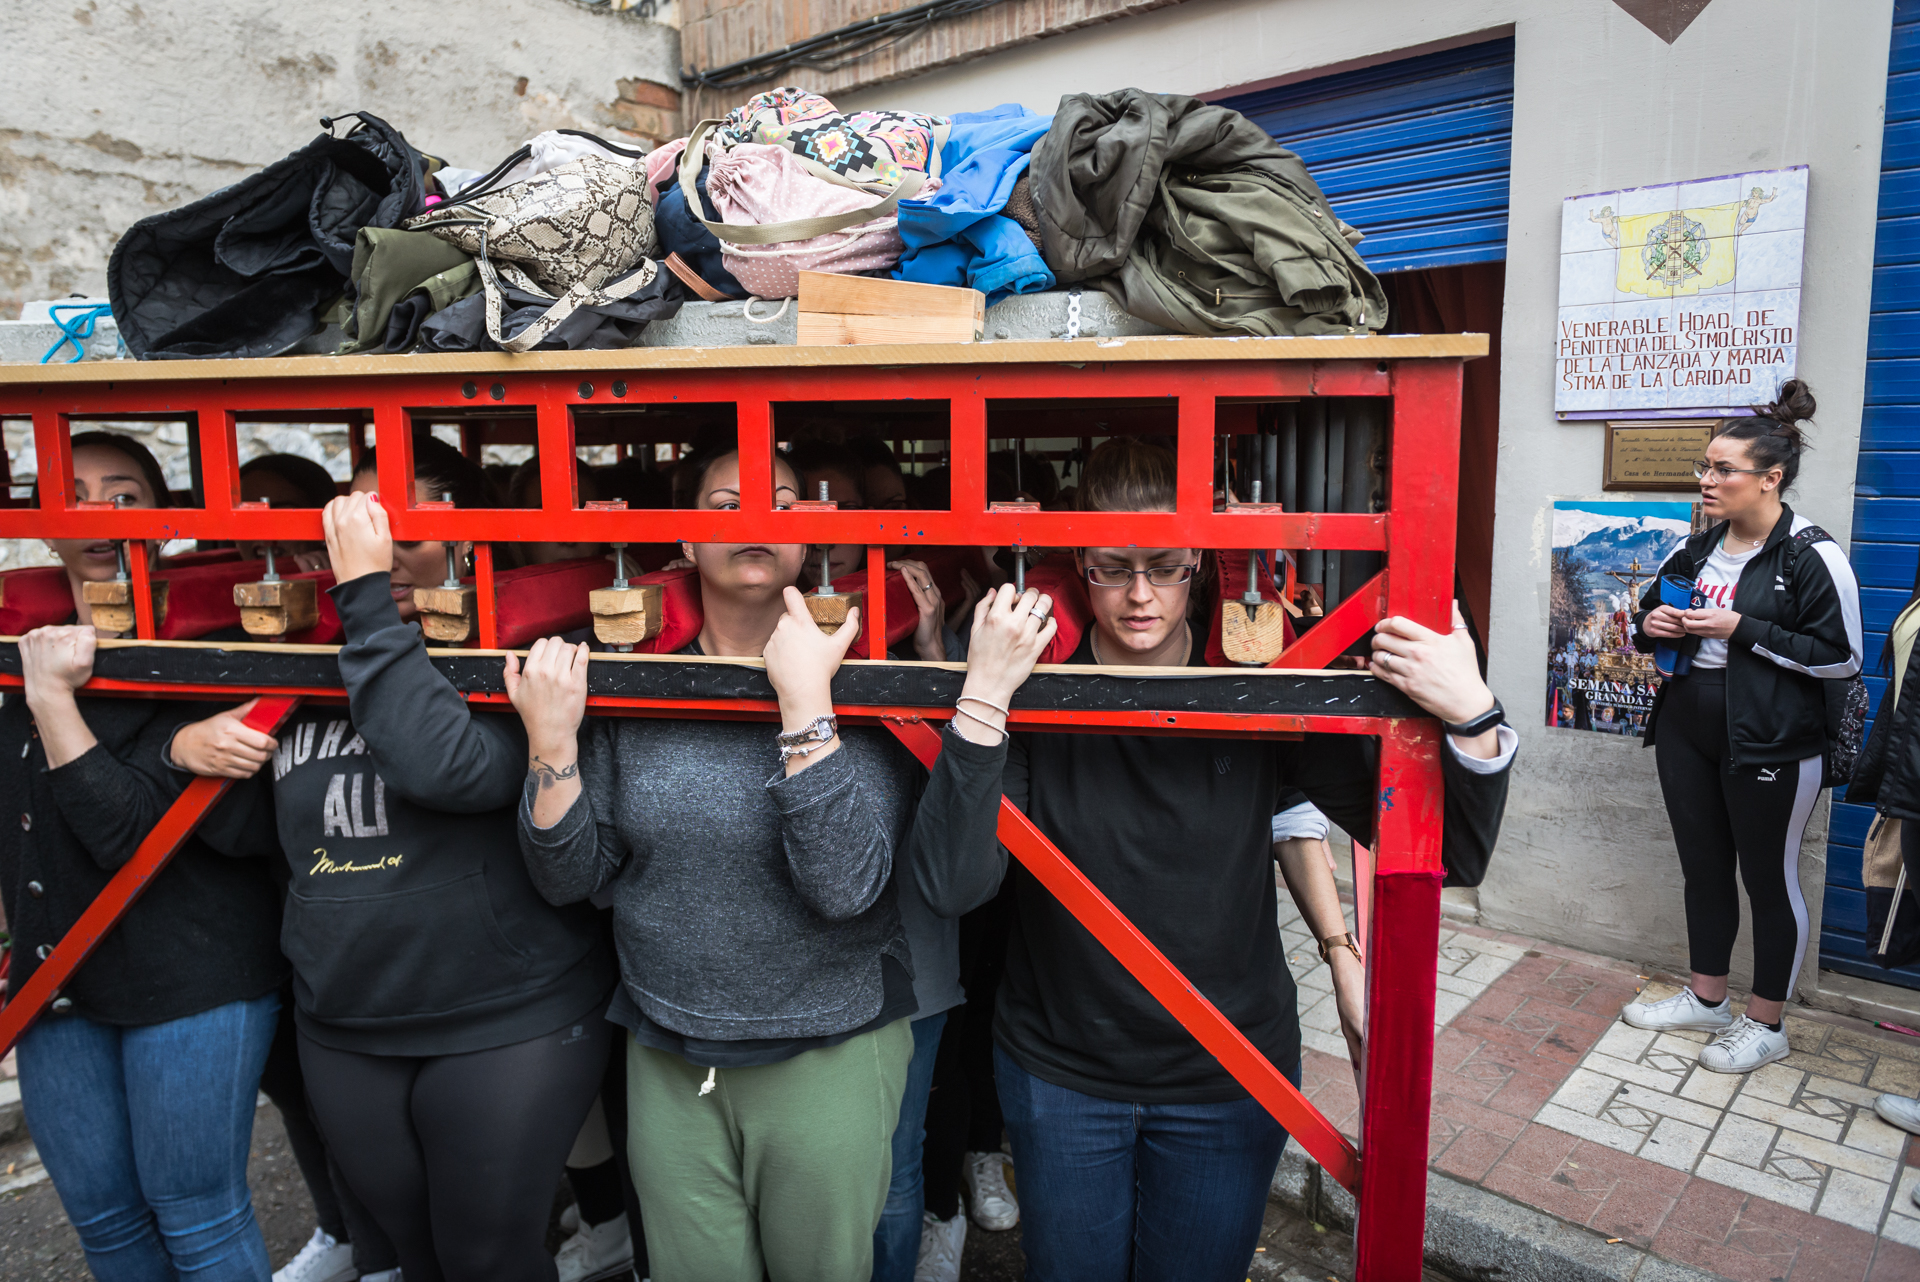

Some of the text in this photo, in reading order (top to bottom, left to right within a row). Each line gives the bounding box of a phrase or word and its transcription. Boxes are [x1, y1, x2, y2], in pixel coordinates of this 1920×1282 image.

[1561, 309, 1774, 338] VENERABLE HDAD. DE
[1560, 337, 1648, 356] PENITENCIA
[1652, 335, 1682, 352] DEL
[1732, 327, 1793, 346] CRISTO
[1564, 347, 1784, 373] DE LA LANZADA Y MARIA
[1612, 373, 1632, 389] DE
[1641, 372, 1663, 388] LA
[1673, 368, 1751, 387] CARIDAD
[1569, 678, 1657, 697] SEMANA SA
[1585, 690, 1643, 706] GRANADA
[272, 720, 371, 782] MUHA
[323, 773, 389, 838] ALI
